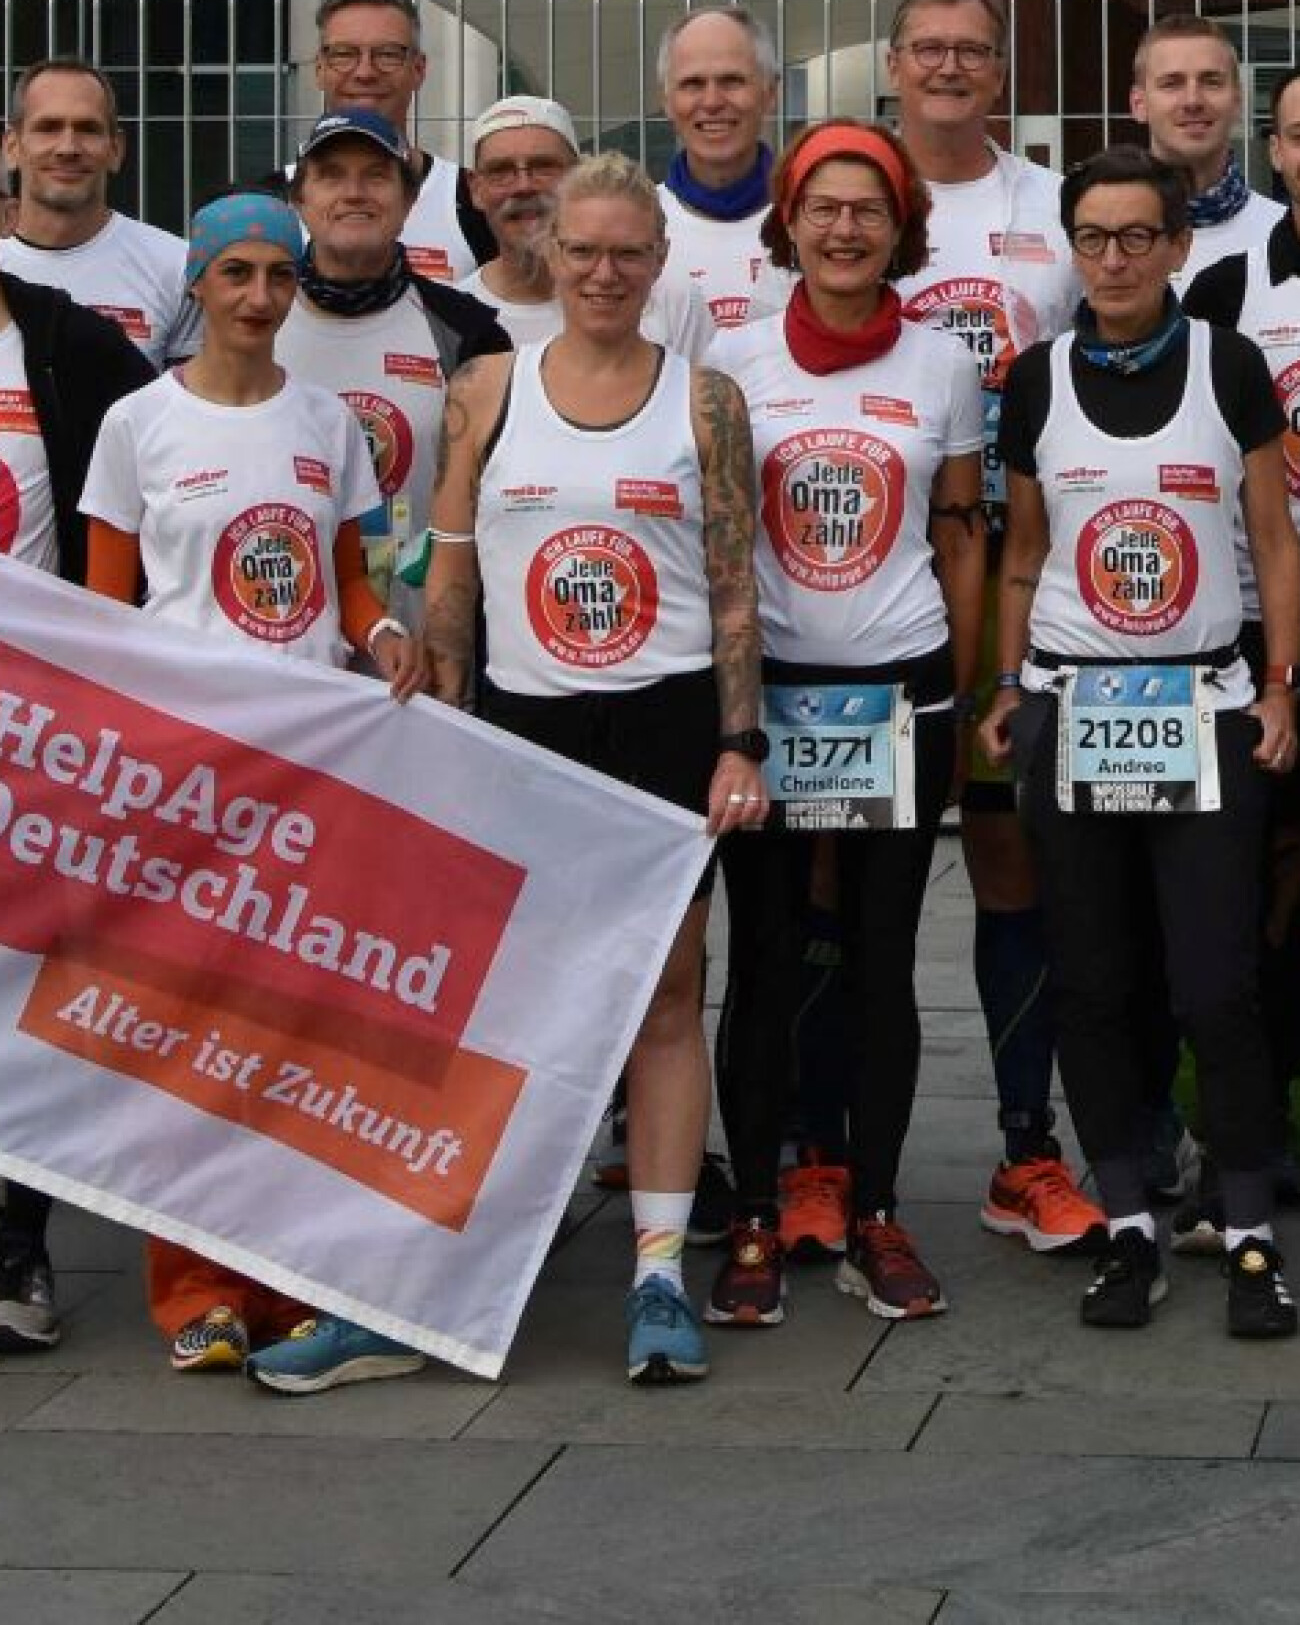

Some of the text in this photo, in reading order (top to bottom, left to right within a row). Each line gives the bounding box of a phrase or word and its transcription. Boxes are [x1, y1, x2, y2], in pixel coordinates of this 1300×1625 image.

[940, 280, 985, 299] LAUFE
[942, 305, 993, 328] Jede
[805, 432, 857, 450] LAUFE
[807, 461, 864, 485] Jede
[791, 480, 863, 515] Oma
[801, 514, 864, 547] zählt
[1116, 530, 1161, 548] Jede
[254, 536, 292, 555] Jede
[241, 554, 293, 581] Oma
[568, 557, 614, 578] Jede
[1103, 546, 1161, 575] Oma
[555, 576, 616, 605] Oma
[1112, 575, 1164, 601] zählt
[565, 604, 623, 632] zählt
[1077, 717, 1184, 749] 21208
[781, 736, 872, 768] 13771
[0, 692, 317, 864] HelpAge
[1098, 758, 1166, 774] Andrea
[779, 774, 875, 793] Christiane
[0, 783, 452, 1014] eutschland
[56, 985, 464, 1176] Alter ist Zukunft
